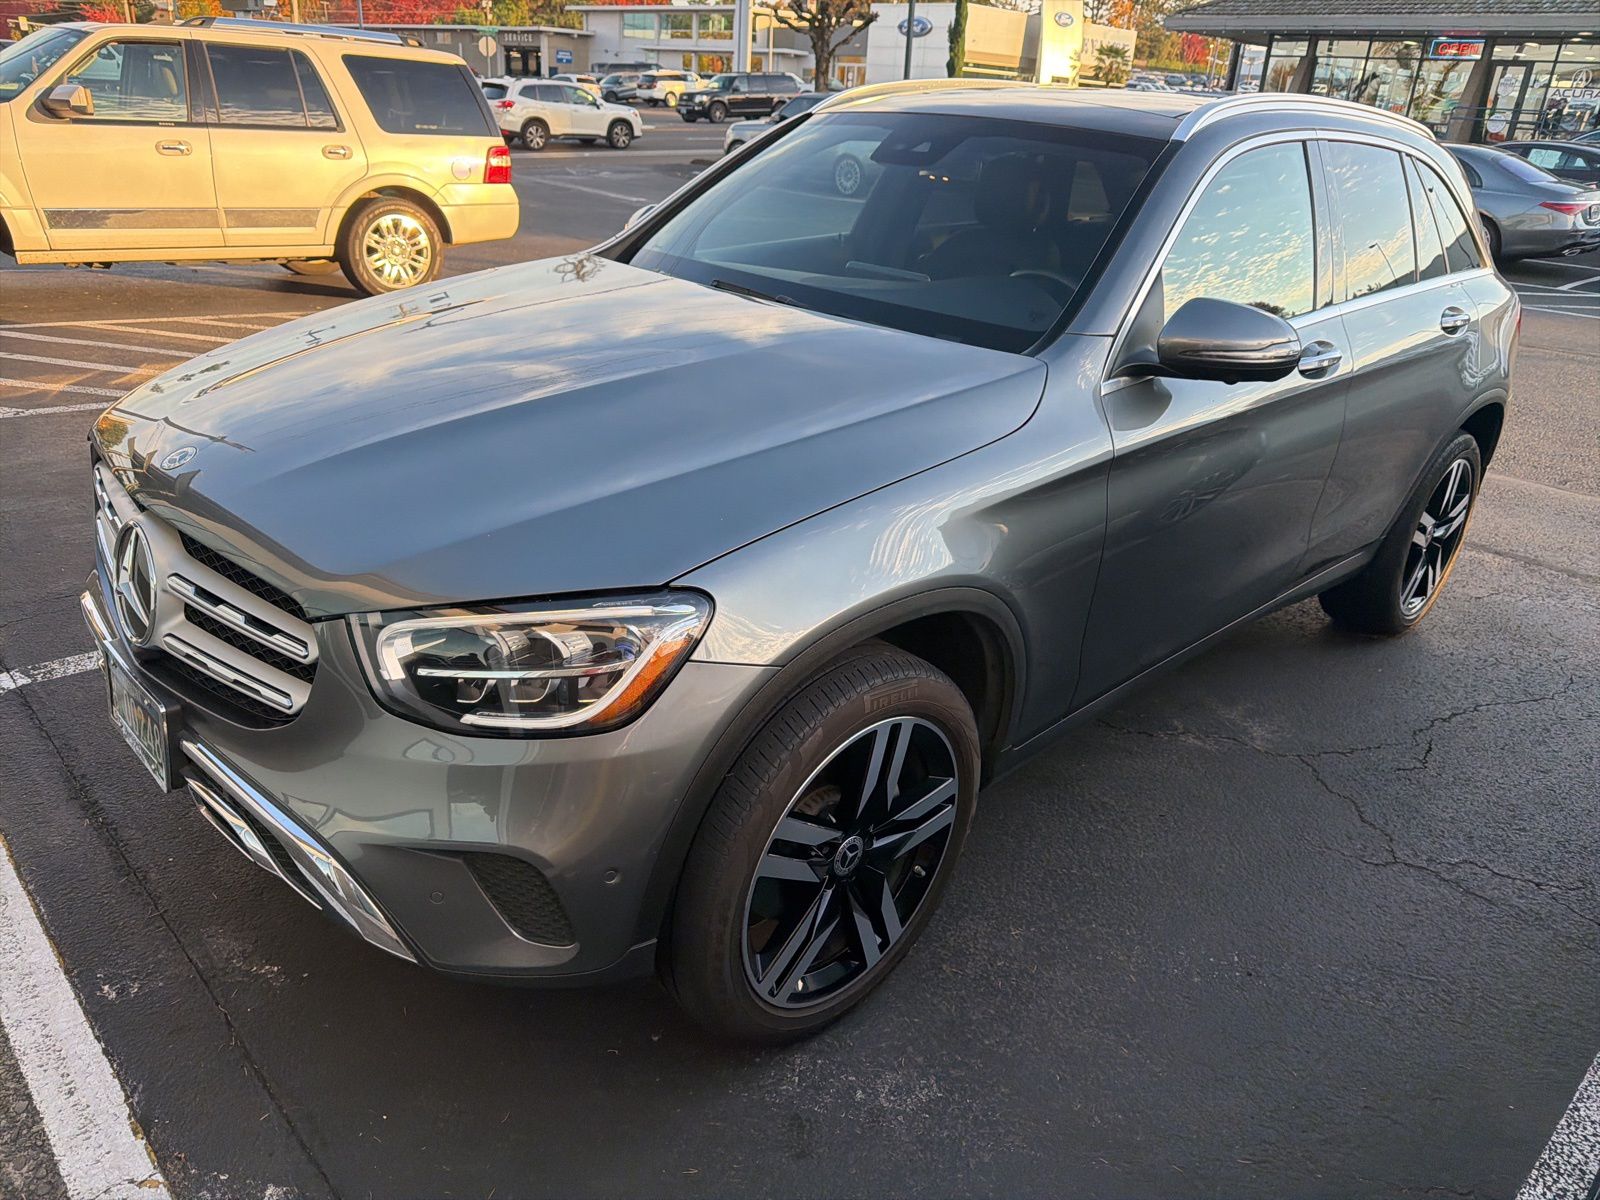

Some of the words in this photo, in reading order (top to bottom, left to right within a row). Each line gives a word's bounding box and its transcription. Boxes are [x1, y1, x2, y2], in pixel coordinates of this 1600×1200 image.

[504, 33, 533, 42] SERVICE
[1438, 43, 1479, 56] OPEN
[1551, 89, 1600, 99] ACURA
[864, 679, 918, 713] PIRELLI
